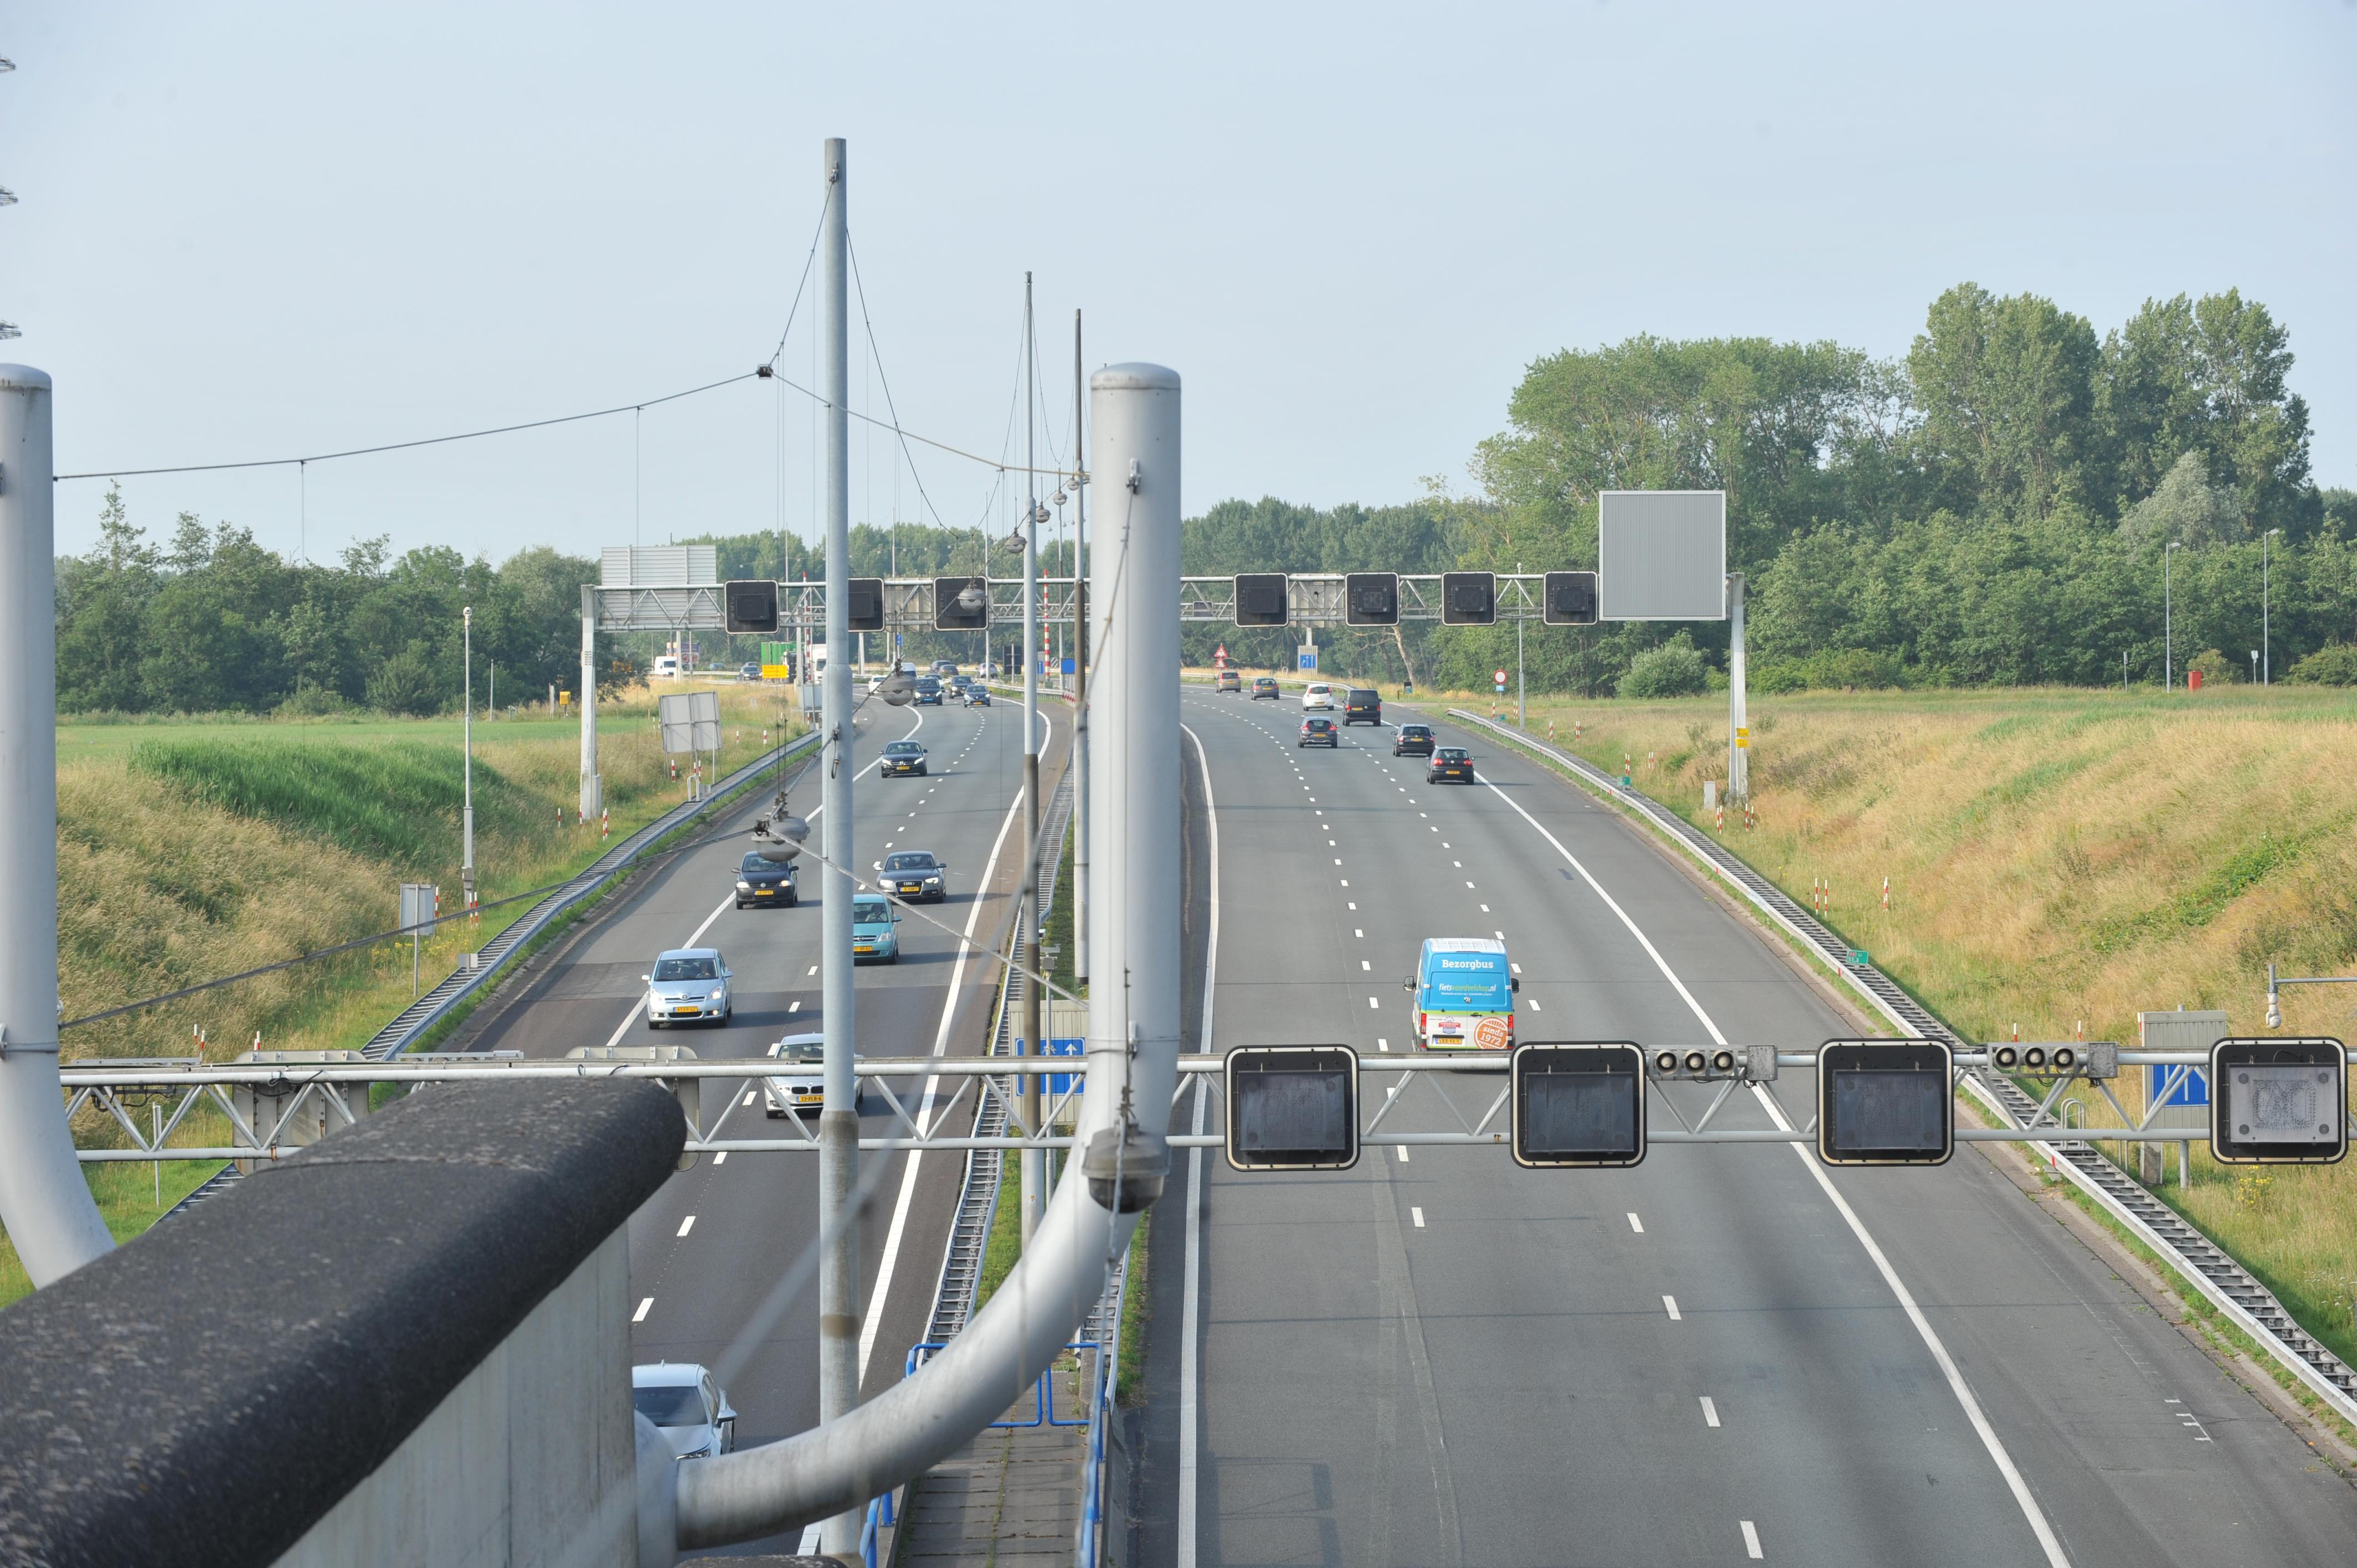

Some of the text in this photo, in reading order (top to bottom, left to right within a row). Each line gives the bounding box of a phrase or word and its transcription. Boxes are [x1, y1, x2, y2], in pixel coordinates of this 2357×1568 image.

[1442, 959, 1494, 970] Bezorgbus
[1439, 983, 1496, 993] fietsvoordeelshop.nl
[1483, 1026, 1504, 1037] sinds
[1480, 1033, 1501, 1045] 1972
